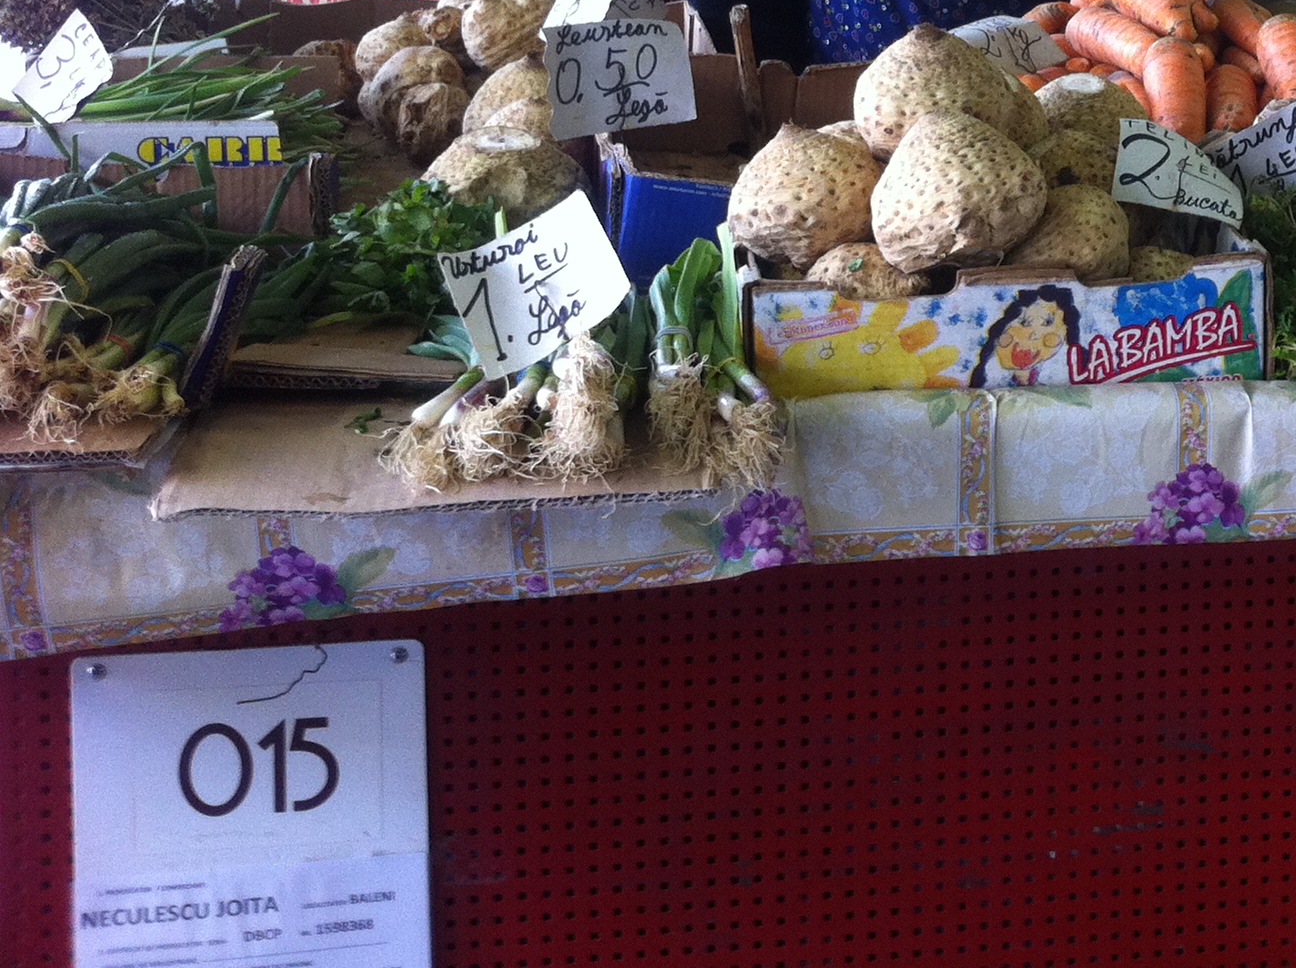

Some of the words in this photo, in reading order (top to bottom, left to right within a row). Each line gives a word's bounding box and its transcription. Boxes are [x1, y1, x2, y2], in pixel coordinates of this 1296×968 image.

[517, 242, 569, 285] LEU
[178, 716, 341, 817] 015
[80, 901, 211, 930] NECULESCU
[215, 895, 280, 919] JOITA
